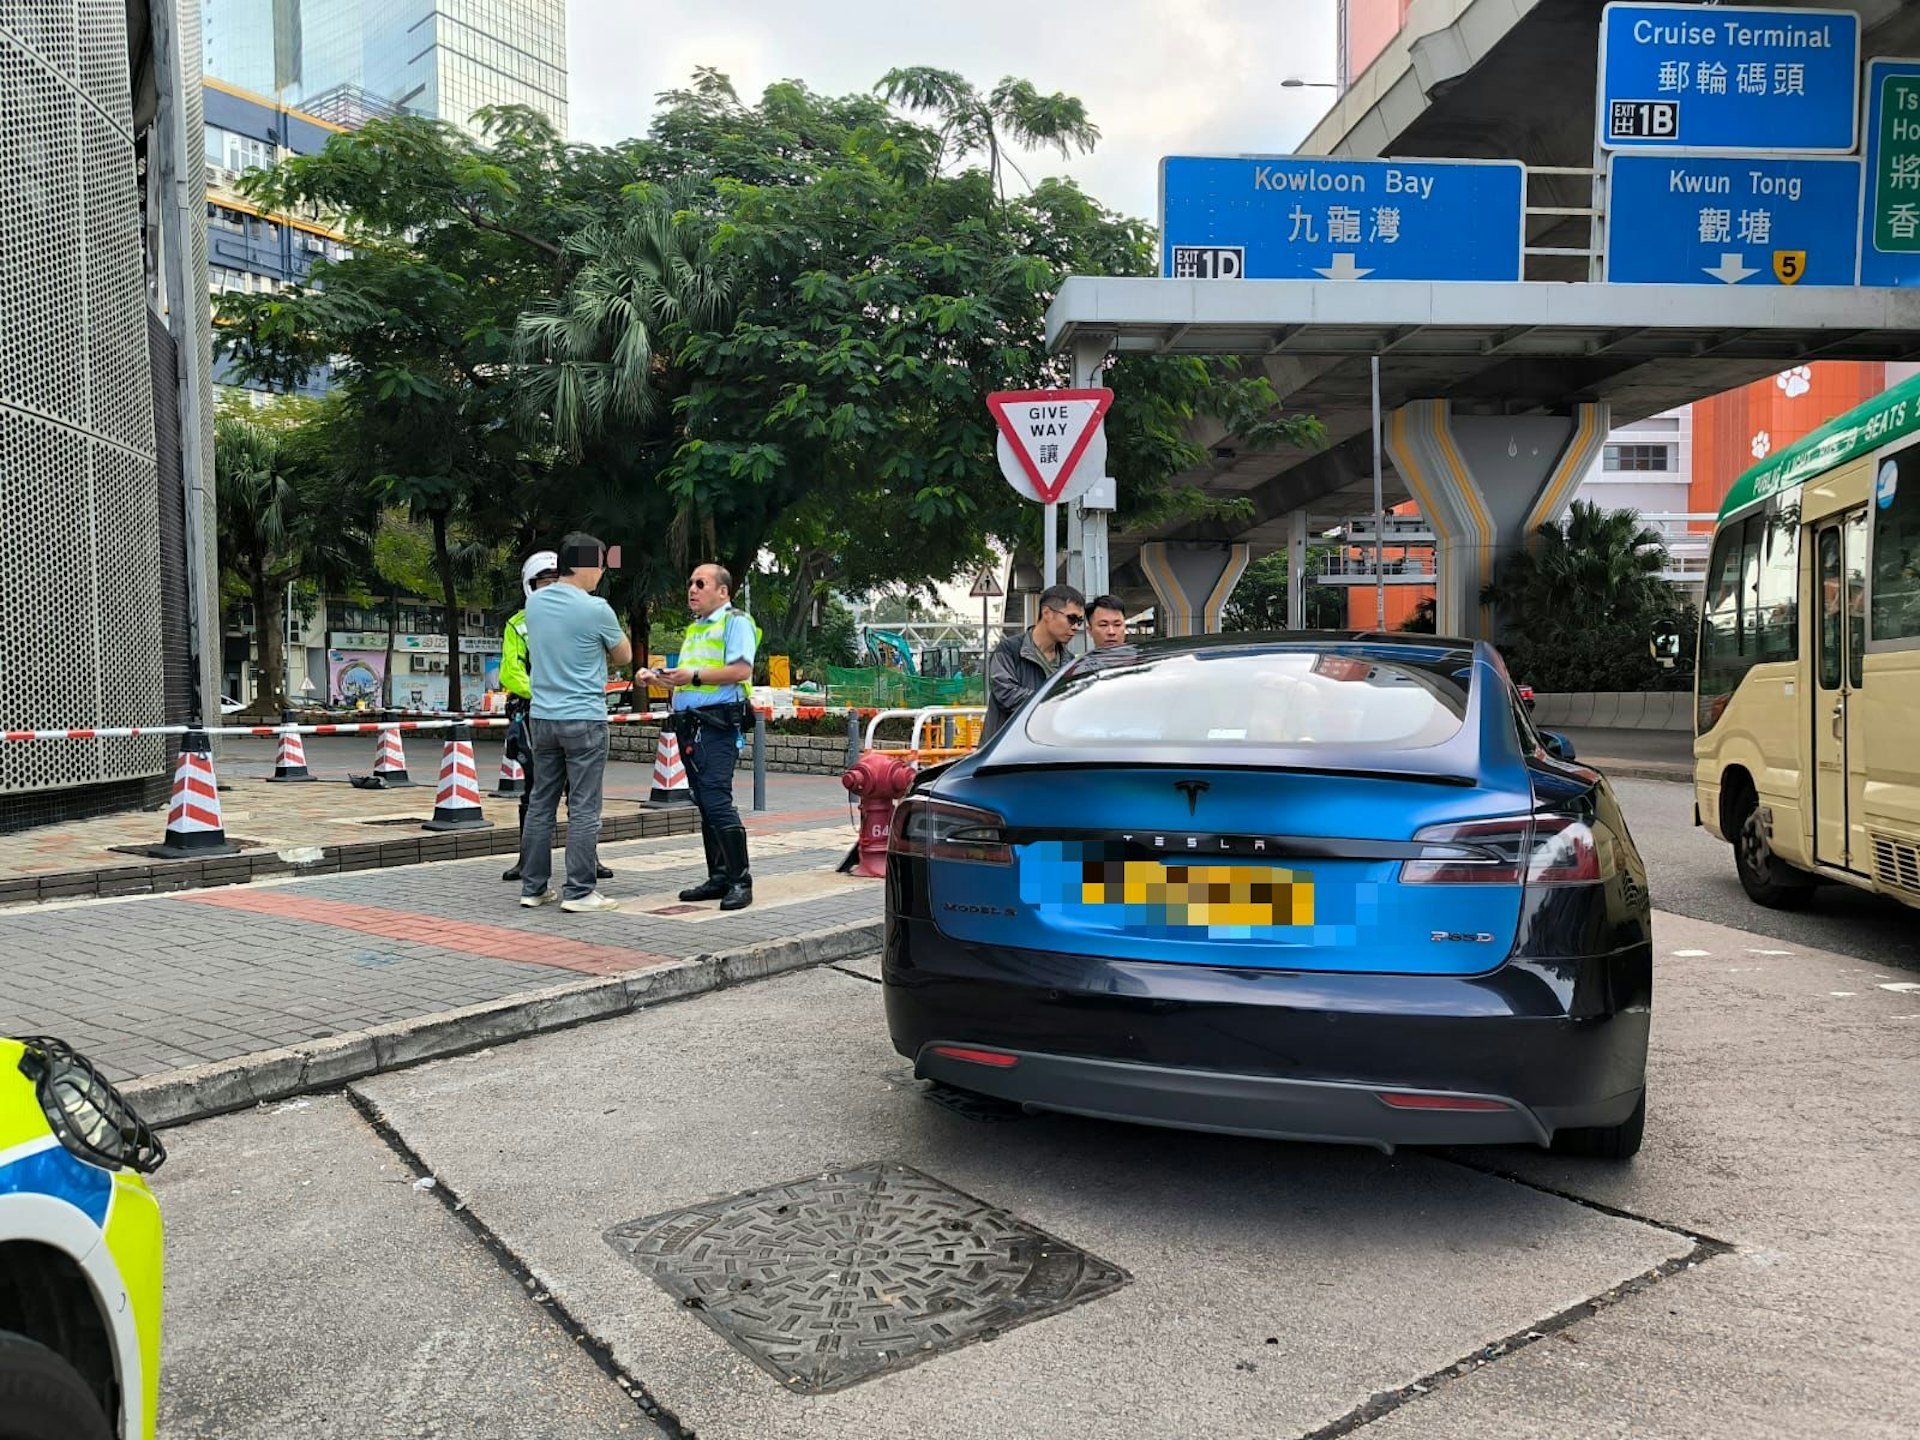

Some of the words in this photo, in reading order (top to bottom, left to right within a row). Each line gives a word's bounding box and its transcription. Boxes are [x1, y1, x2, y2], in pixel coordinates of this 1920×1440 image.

[1633, 20, 1716, 45] Cruise
[1724, 22, 1831, 48] Terminal
[1657, 60, 1805, 96] 郵輪碼頭
[1614, 104, 1636, 117] EXIT
[1639, 104, 1674, 136] 1B
[1613, 117, 1634, 135] 出
[1254, 166, 1365, 192] Kowloon
[1386, 169, 1435, 199] Bay
[1670, 169, 1730, 194] Kwun
[1749, 171, 1802, 201] Tong
[1288, 204, 1401, 244] 九龍灣
[1698, 207, 1772, 245] 觀塘
[1887, 203, 1920, 239] 香
[1176, 249, 1199, 264] EXIT
[1202, 250, 1240, 278] 1D
[1782, 256, 1797, 277] 5
[1029, 406, 1068, 420] GIVE
[1864, 401, 1907, 441] SEATS
[1030, 423, 1068, 437] WAY
[1040, 444, 1058, 463] 讓
[1122, 834, 1266, 851] TESLA
[944, 901, 1001, 915] MODEL
[1430, 930, 1495, 942] P85D
